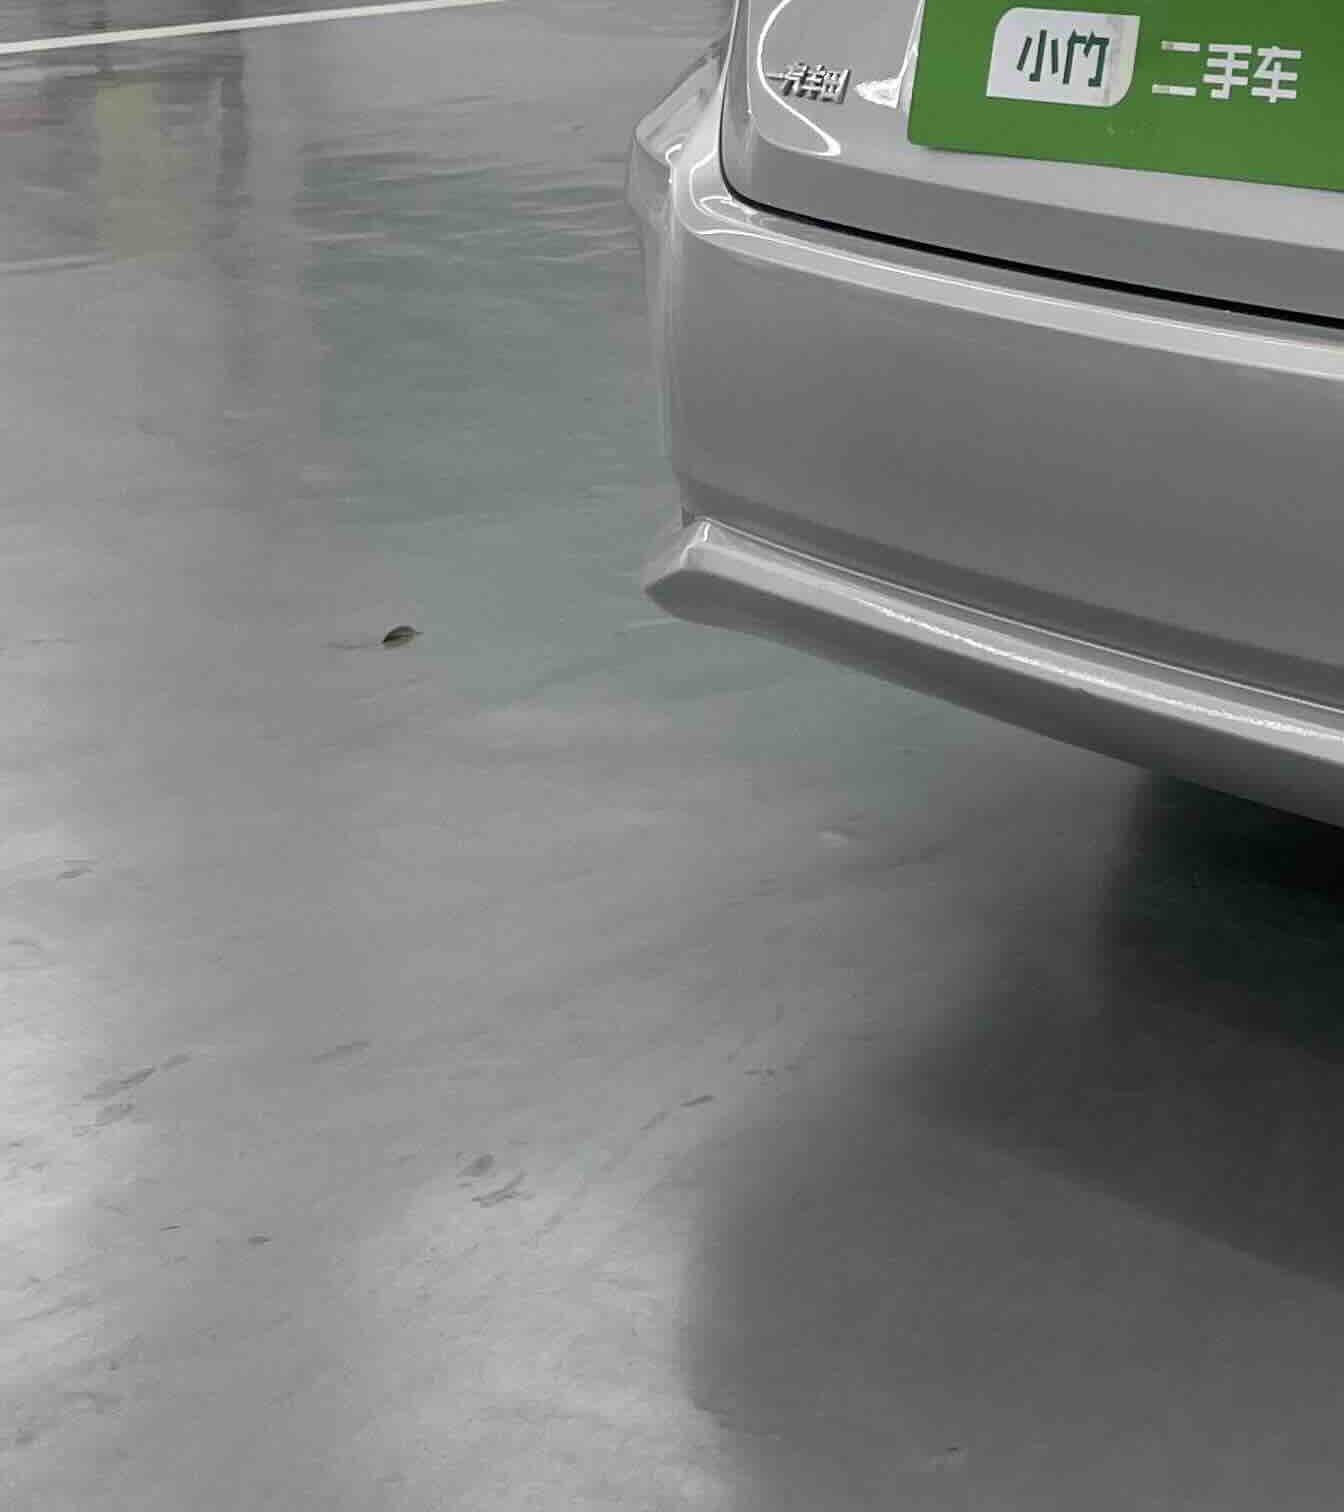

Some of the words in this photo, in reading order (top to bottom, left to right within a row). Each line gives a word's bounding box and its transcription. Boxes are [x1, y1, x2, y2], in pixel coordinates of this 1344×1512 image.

[1016, 28, 1111, 88] 小竹
[1151, 39, 1302, 104] 二手车
